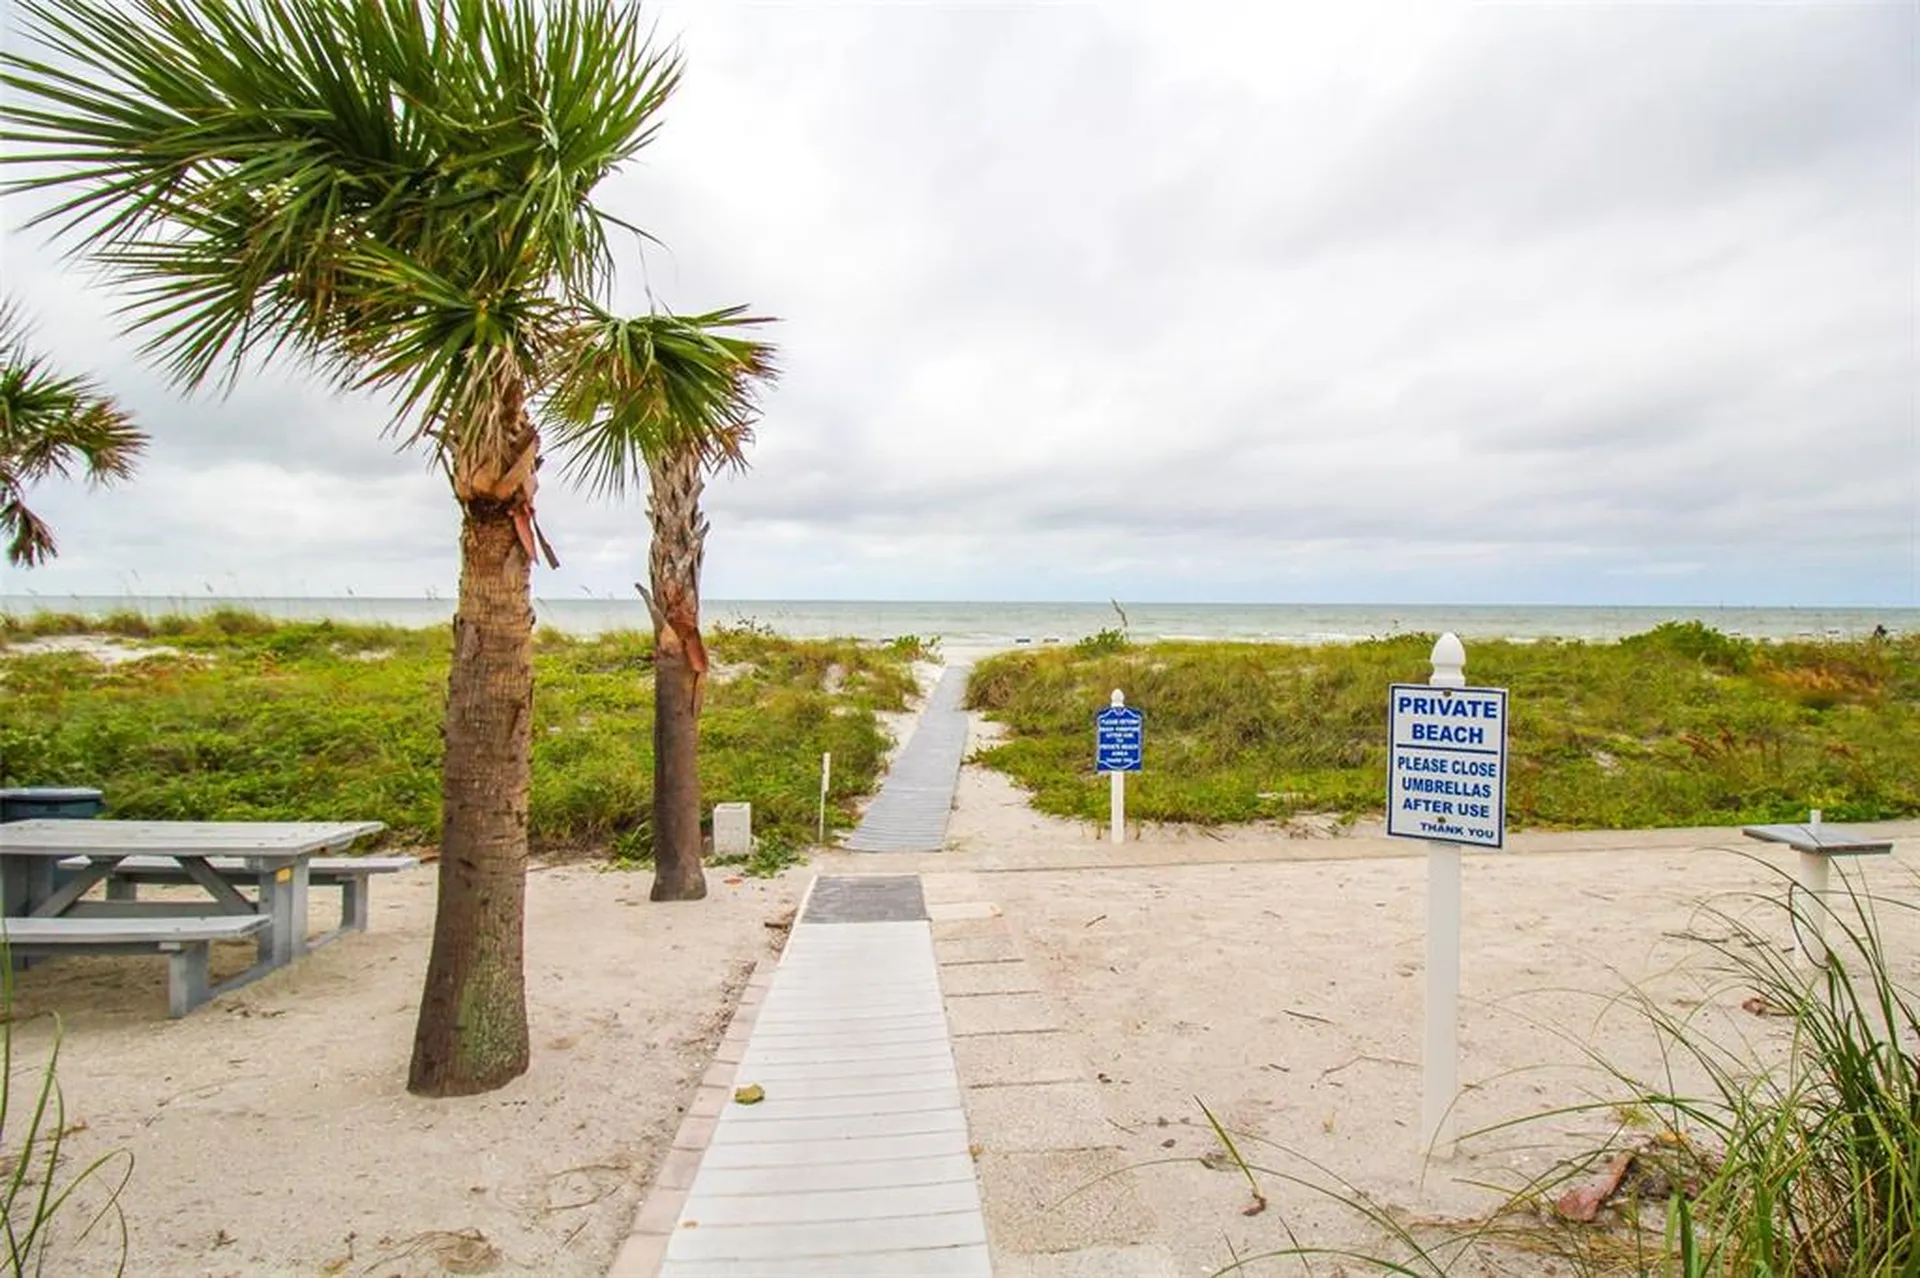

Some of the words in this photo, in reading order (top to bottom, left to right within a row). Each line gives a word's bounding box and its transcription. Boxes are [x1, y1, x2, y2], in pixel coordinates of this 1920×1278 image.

[1398, 697, 1498, 719] PRIVATE
[1411, 723, 1484, 744] BEACH
[1398, 756, 1447, 774] PLEASE
[1452, 760, 1497, 778] CLOSE
[1402, 777, 1492, 799] UMBRELLAS
[1402, 798, 1453, 815] AFTER
[1458, 803, 1490, 818] USE
[1420, 822, 1464, 836] THANK
[1468, 828, 1494, 839] YOU
